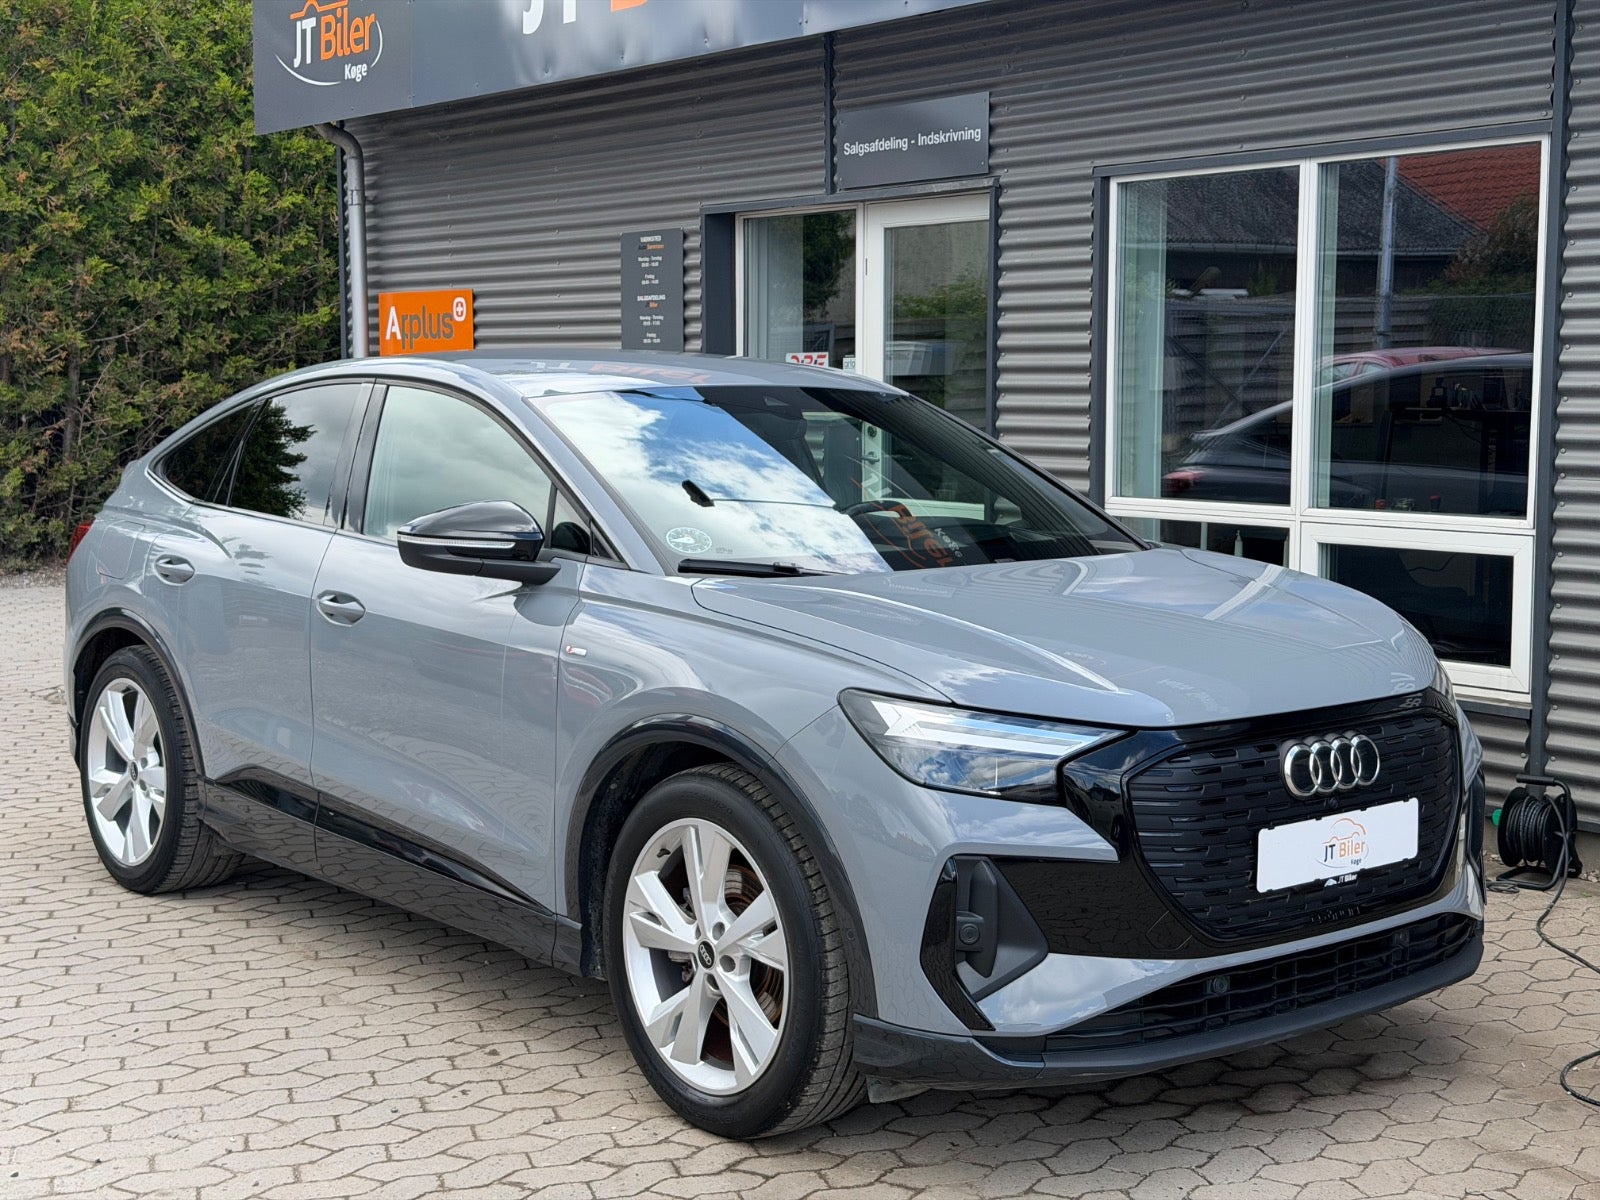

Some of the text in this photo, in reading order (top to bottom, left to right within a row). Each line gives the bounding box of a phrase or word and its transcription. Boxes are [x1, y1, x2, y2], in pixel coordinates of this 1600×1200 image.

[293, 7, 375, 68] JT Biler
[344, 63, 368, 82] Køge
[843, 136, 908, 156] Salgsafdeling
[918, 127, 981, 146] Indskrivning
[1324, 840, 1366, 863] JT Biler
